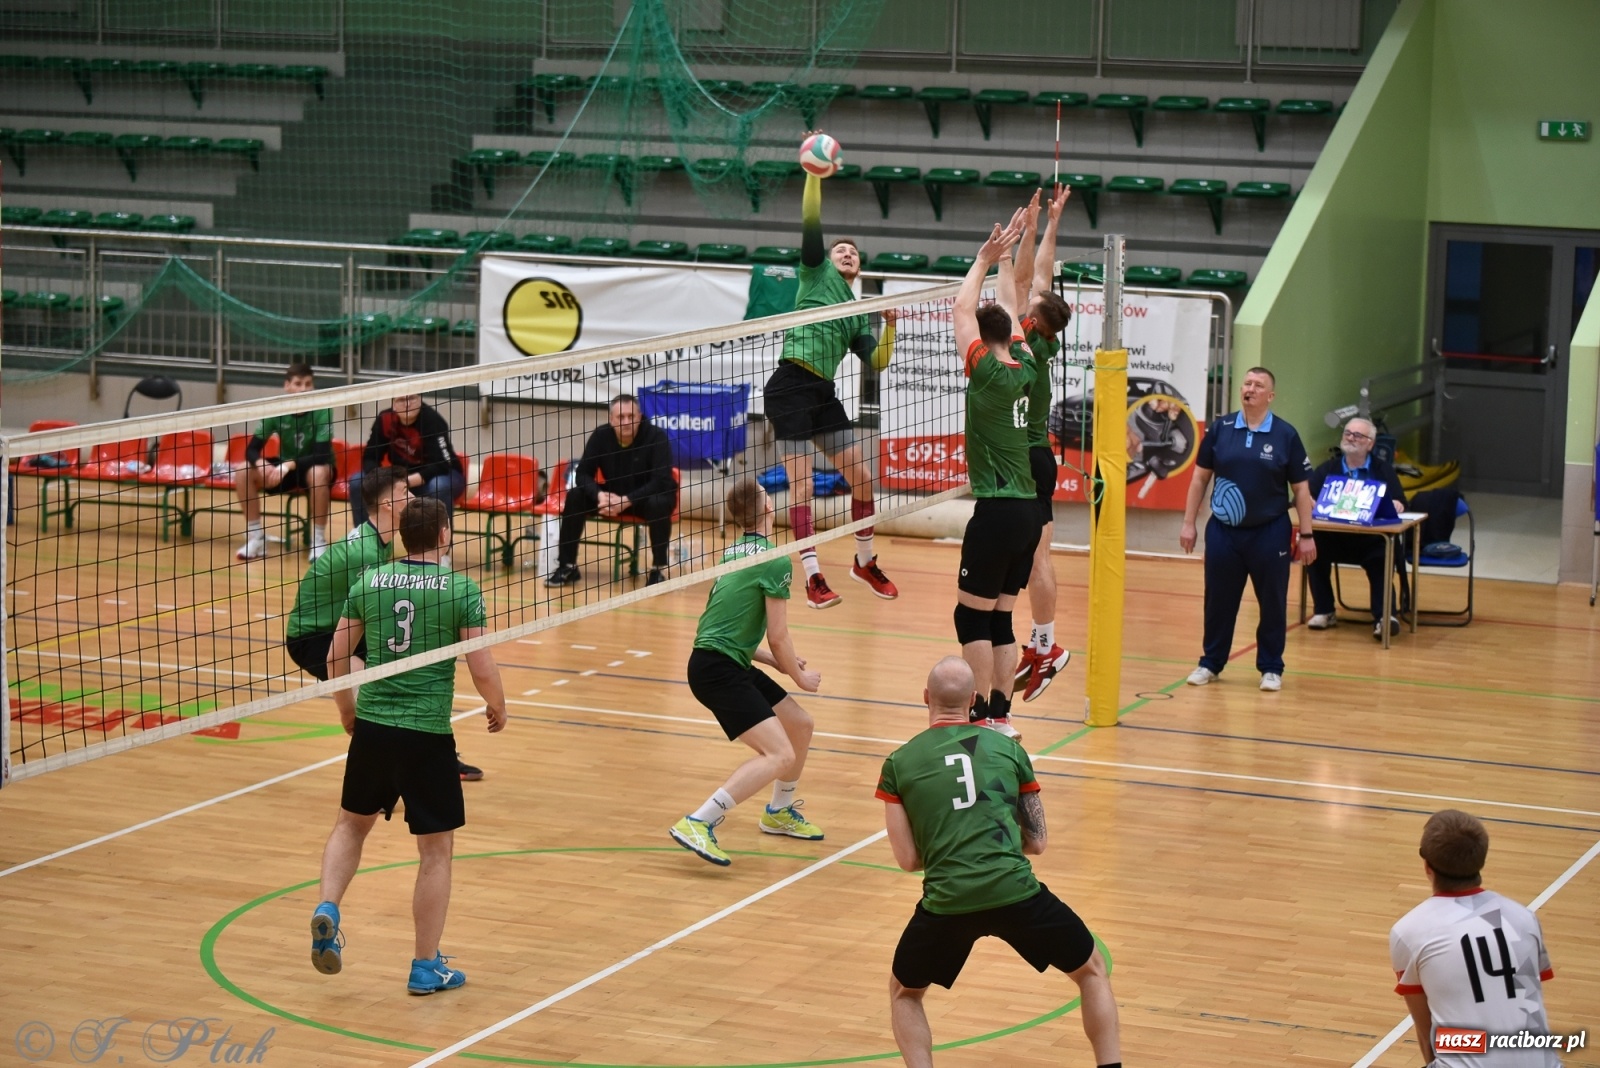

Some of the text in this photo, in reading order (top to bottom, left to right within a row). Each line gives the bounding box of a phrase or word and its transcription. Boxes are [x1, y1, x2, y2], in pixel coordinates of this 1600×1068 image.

[1061, 479, 1078, 492] 45
[387, 599, 416, 654] 3
[944, 753, 977, 811] 3
[1460, 927, 1517, 1004] 14
